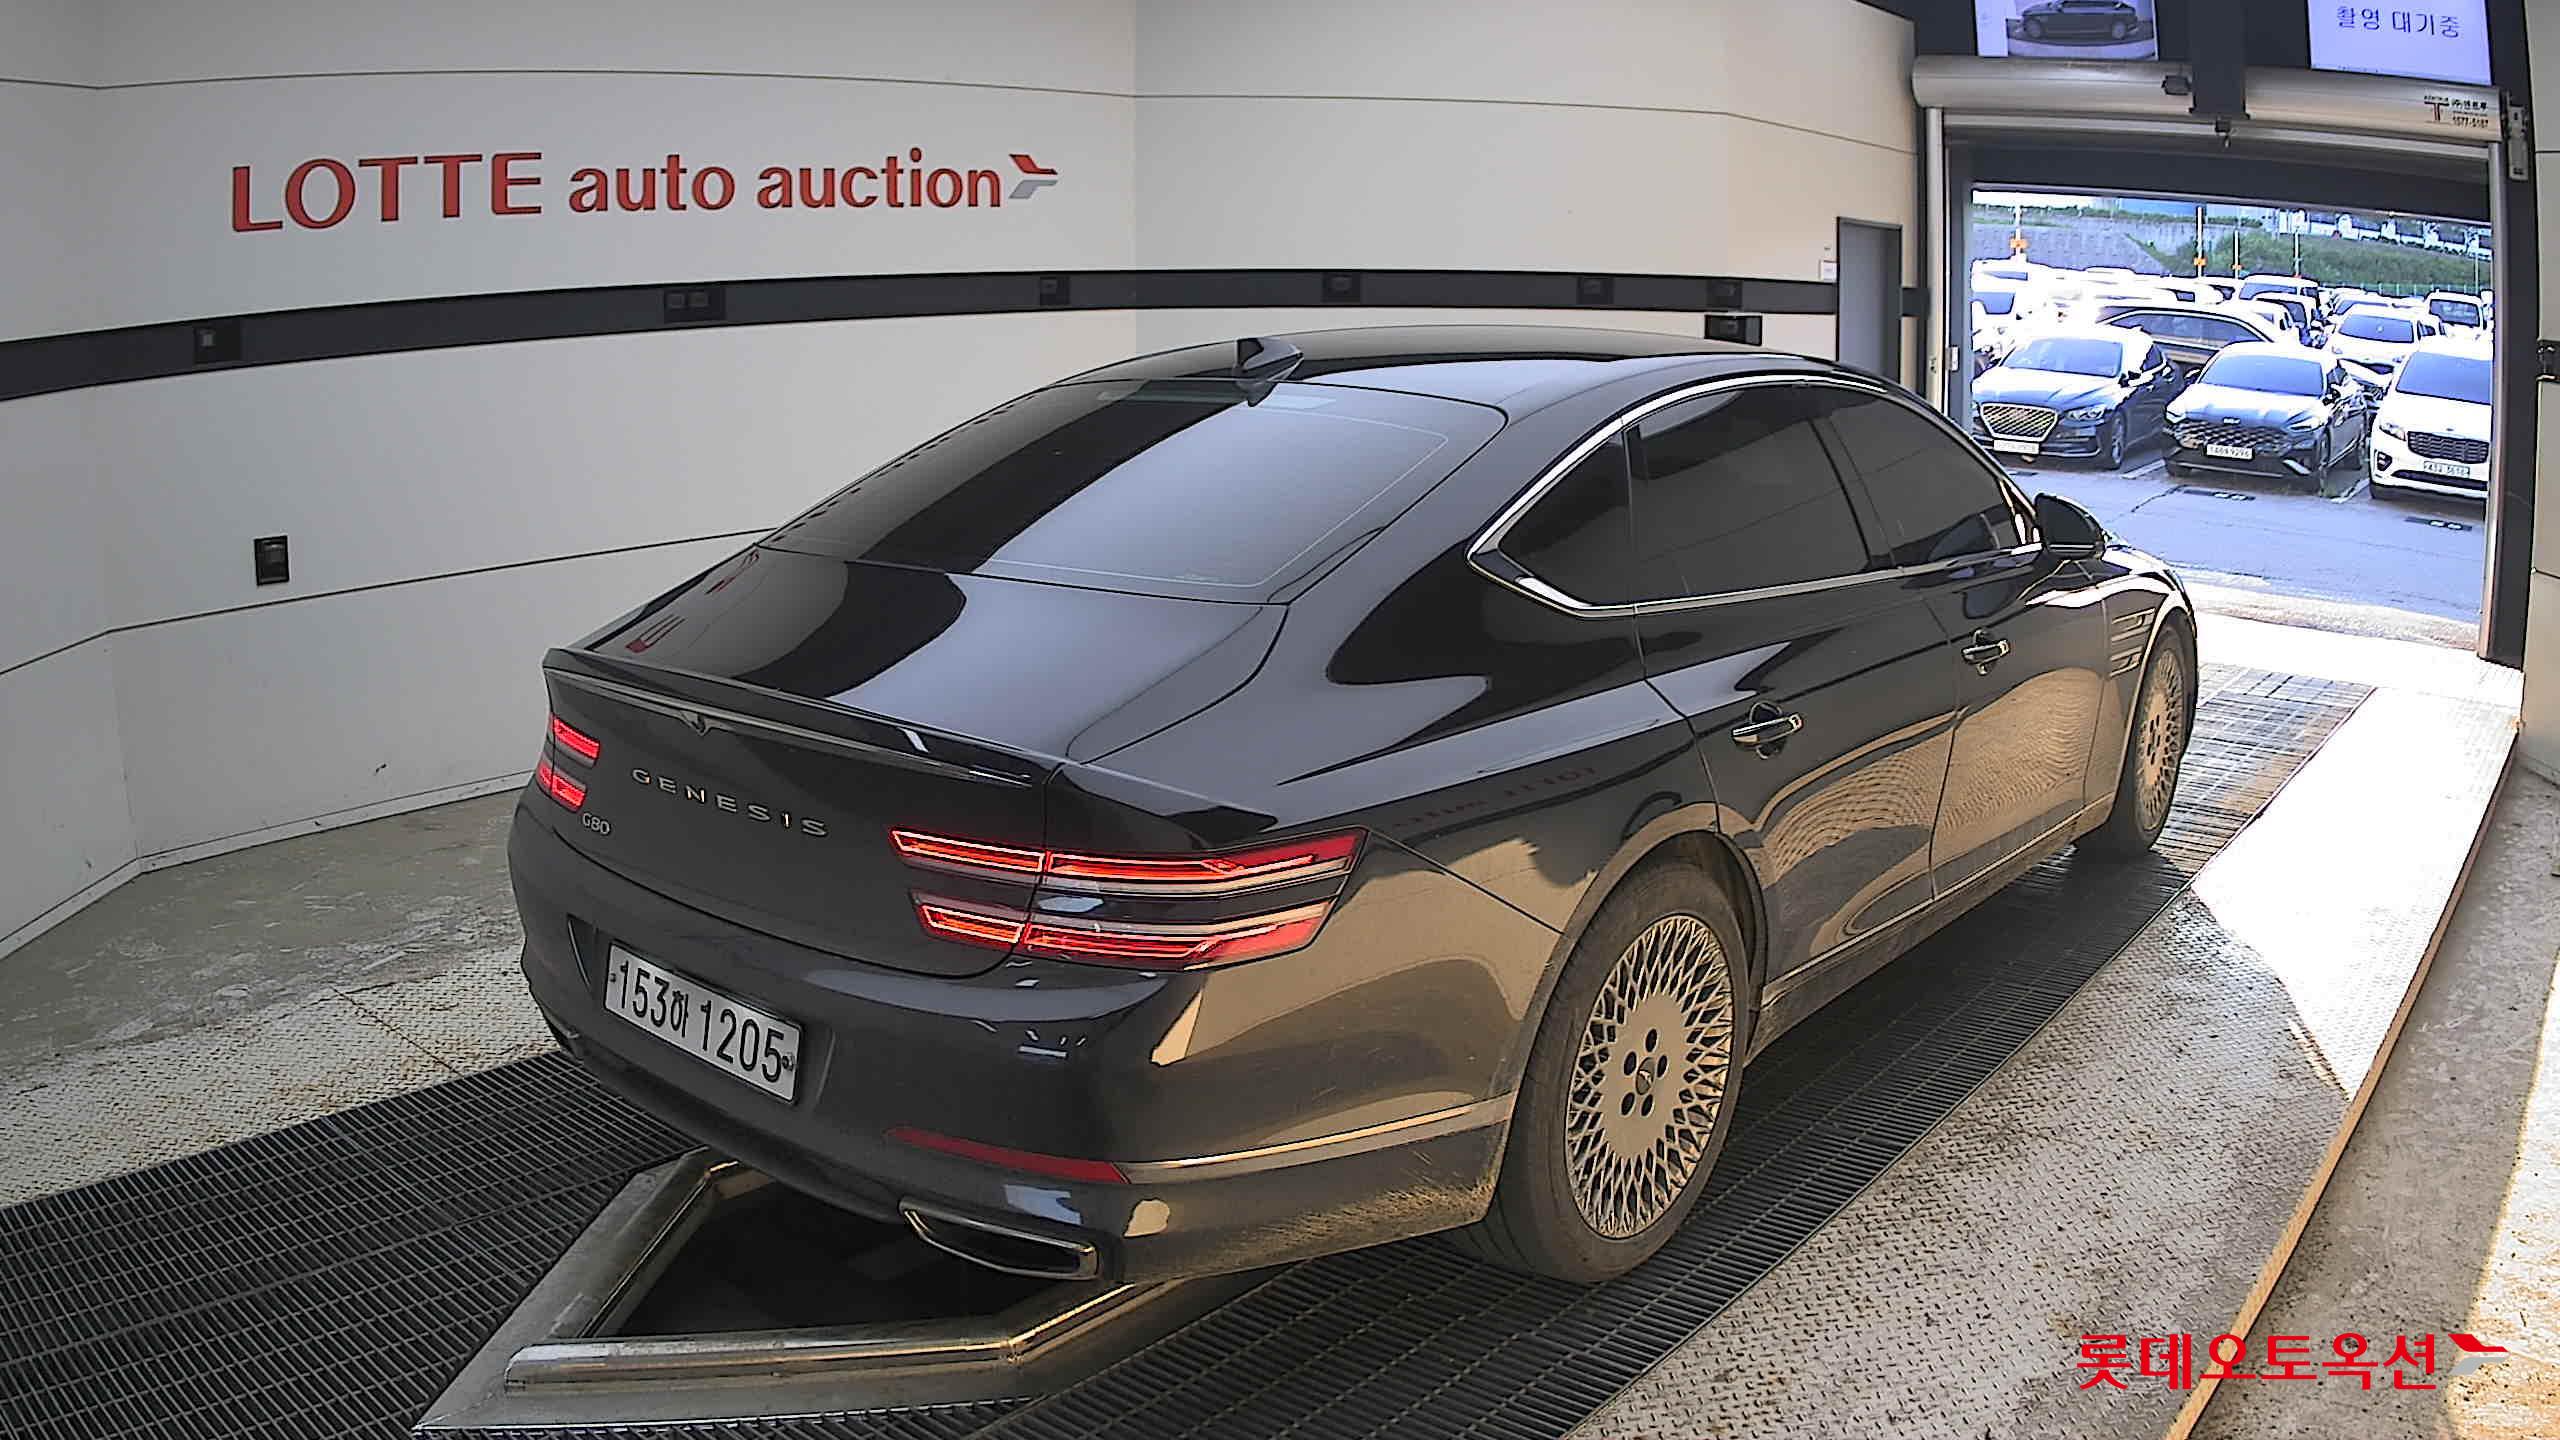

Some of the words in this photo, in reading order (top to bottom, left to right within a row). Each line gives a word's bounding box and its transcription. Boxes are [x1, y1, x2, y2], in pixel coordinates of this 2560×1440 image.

[2336, 6, 2380, 31] 촬영
[2392, 10, 2460, 38] 대기중
[232, 151, 542, 233] LOTTE
[568, 153, 736, 213] auto
[756, 147, 1002, 209] auction
[581, 811, 611, 836] G80
[631, 768, 828, 837] GENESIS
